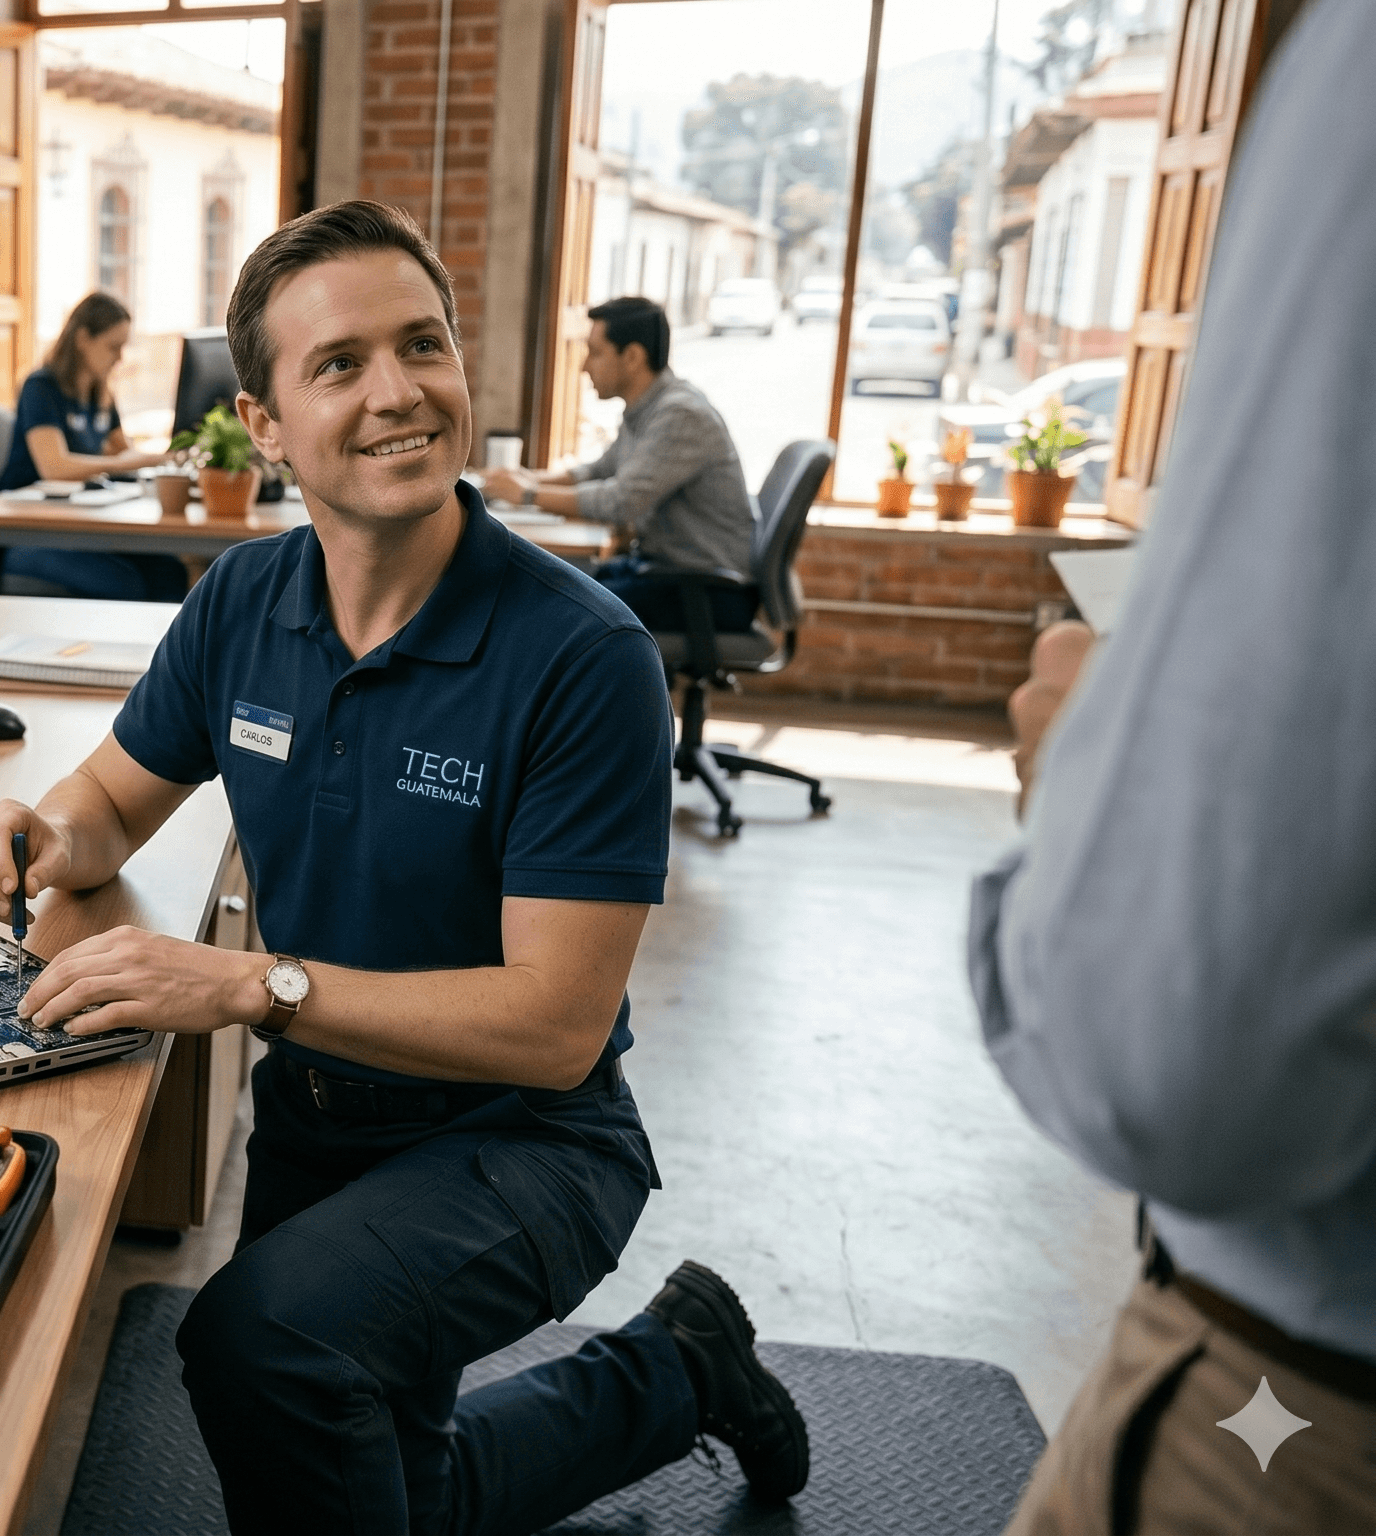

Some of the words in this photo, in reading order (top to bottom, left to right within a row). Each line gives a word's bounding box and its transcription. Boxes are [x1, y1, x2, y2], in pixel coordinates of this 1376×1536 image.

[240, 728, 273, 747] CARLOS
[403, 746, 484, 791] TECH
[396, 778, 482, 808] GUATEMALA
